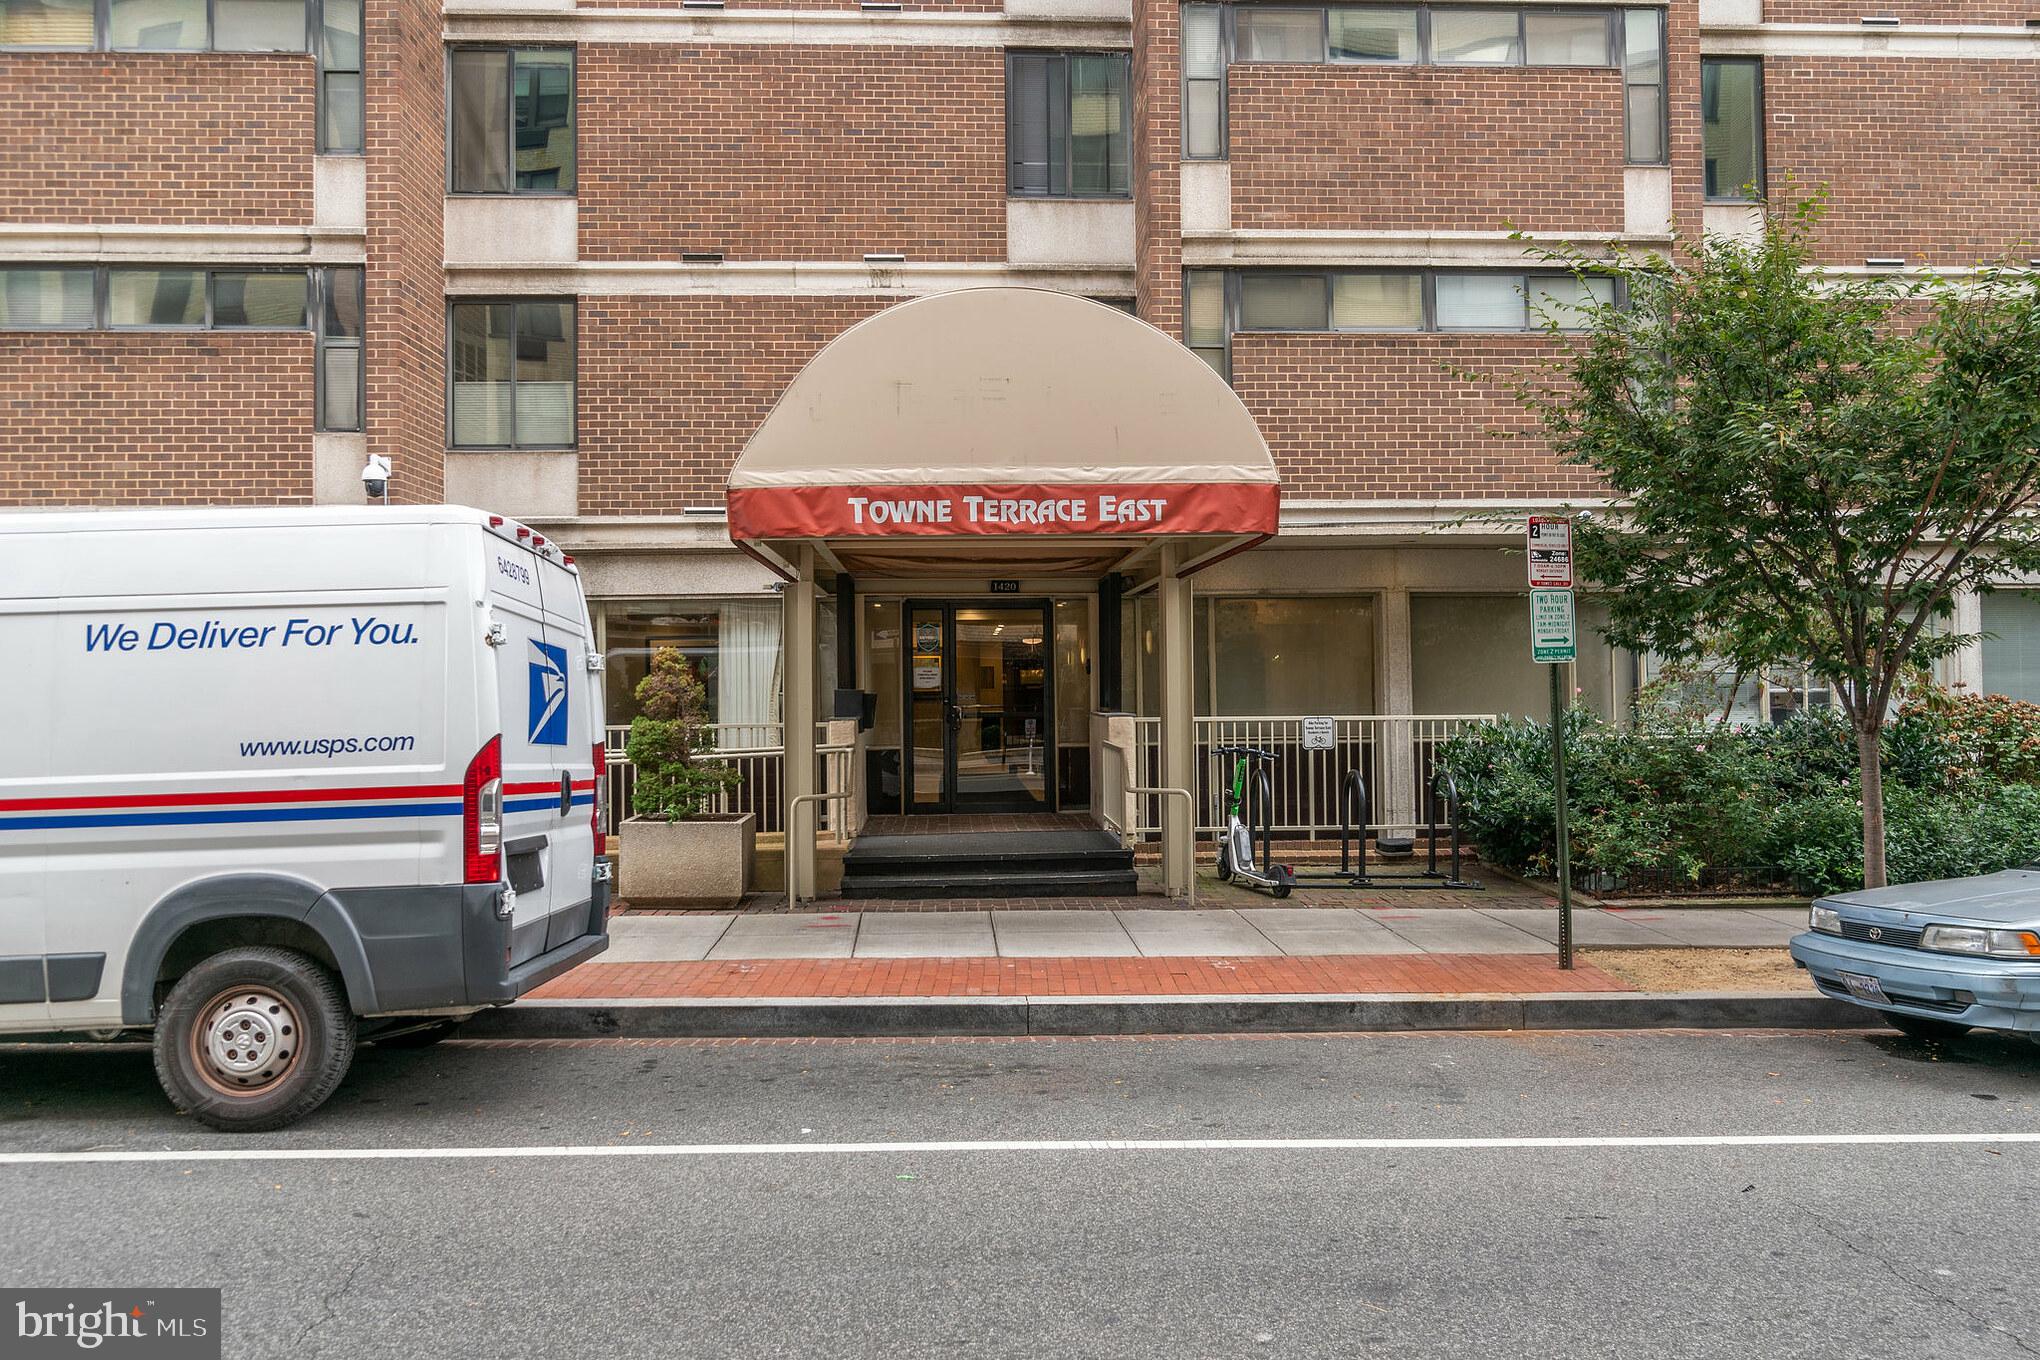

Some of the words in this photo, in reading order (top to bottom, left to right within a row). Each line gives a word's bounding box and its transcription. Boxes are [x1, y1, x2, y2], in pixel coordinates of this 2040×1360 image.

[847, 496, 953, 524] TOWNE
[962, 495, 1087, 525] TERRACE
[1099, 495, 1168, 524] EAST
[1532, 525, 1538, 537] 2
[993, 582, 1017, 591] 1420
[1536, 595, 1548, 604] TWO
[1550, 594, 1568, 604] HOUR
[86, 624, 139, 653] We
[147, 621, 275, 651] Deliver
[282, 618, 341, 647] For
[351, 617, 420, 646] You.
[240, 735, 415, 758] www.usps.com
